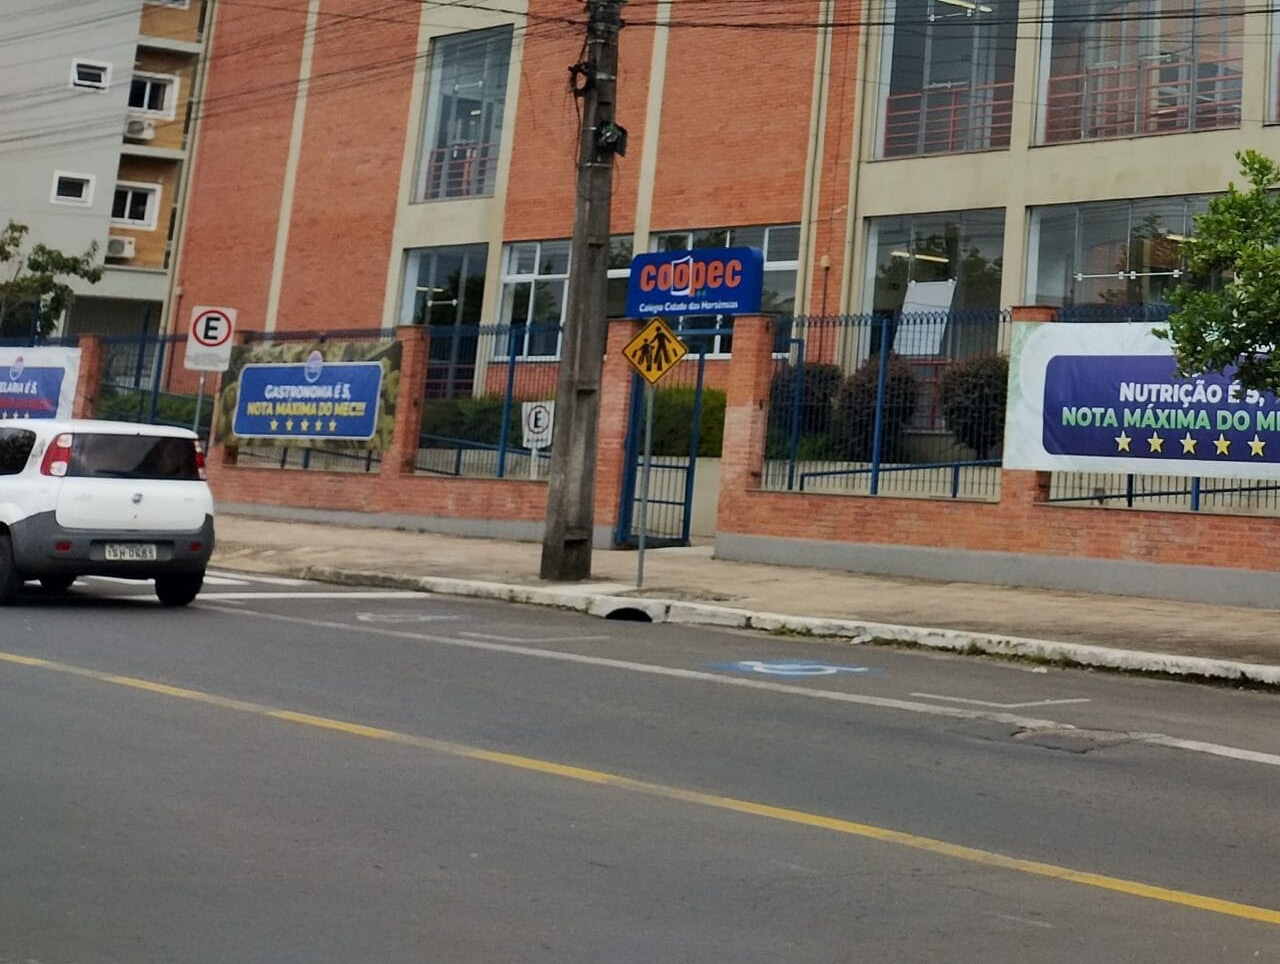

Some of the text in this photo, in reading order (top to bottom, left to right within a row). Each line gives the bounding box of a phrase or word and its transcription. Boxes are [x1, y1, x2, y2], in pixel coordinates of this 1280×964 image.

[640, 259, 742, 297] coopec
[664, 301, 687, 311] Cidade
[688, 301, 700, 310] das
[203, 317, 221, 340] E
[264, 384, 333, 399] GASTRONOMIA
[333, 382, 341, 399] É
[1119, 379, 1220, 408] NUTRIÇÃO
[1227, 380, 1241, 403] É
[247, 402, 273, 415] NOTA
[275, 399, 317, 416] MÁXIMA
[318, 402, 333, 416] DO
[534, 410, 545, 428] E
[1062, 407, 1118, 428] NOTA
[1123, 404, 1211, 430] MÁXIMA
[1216, 411, 1250, 432] DO
